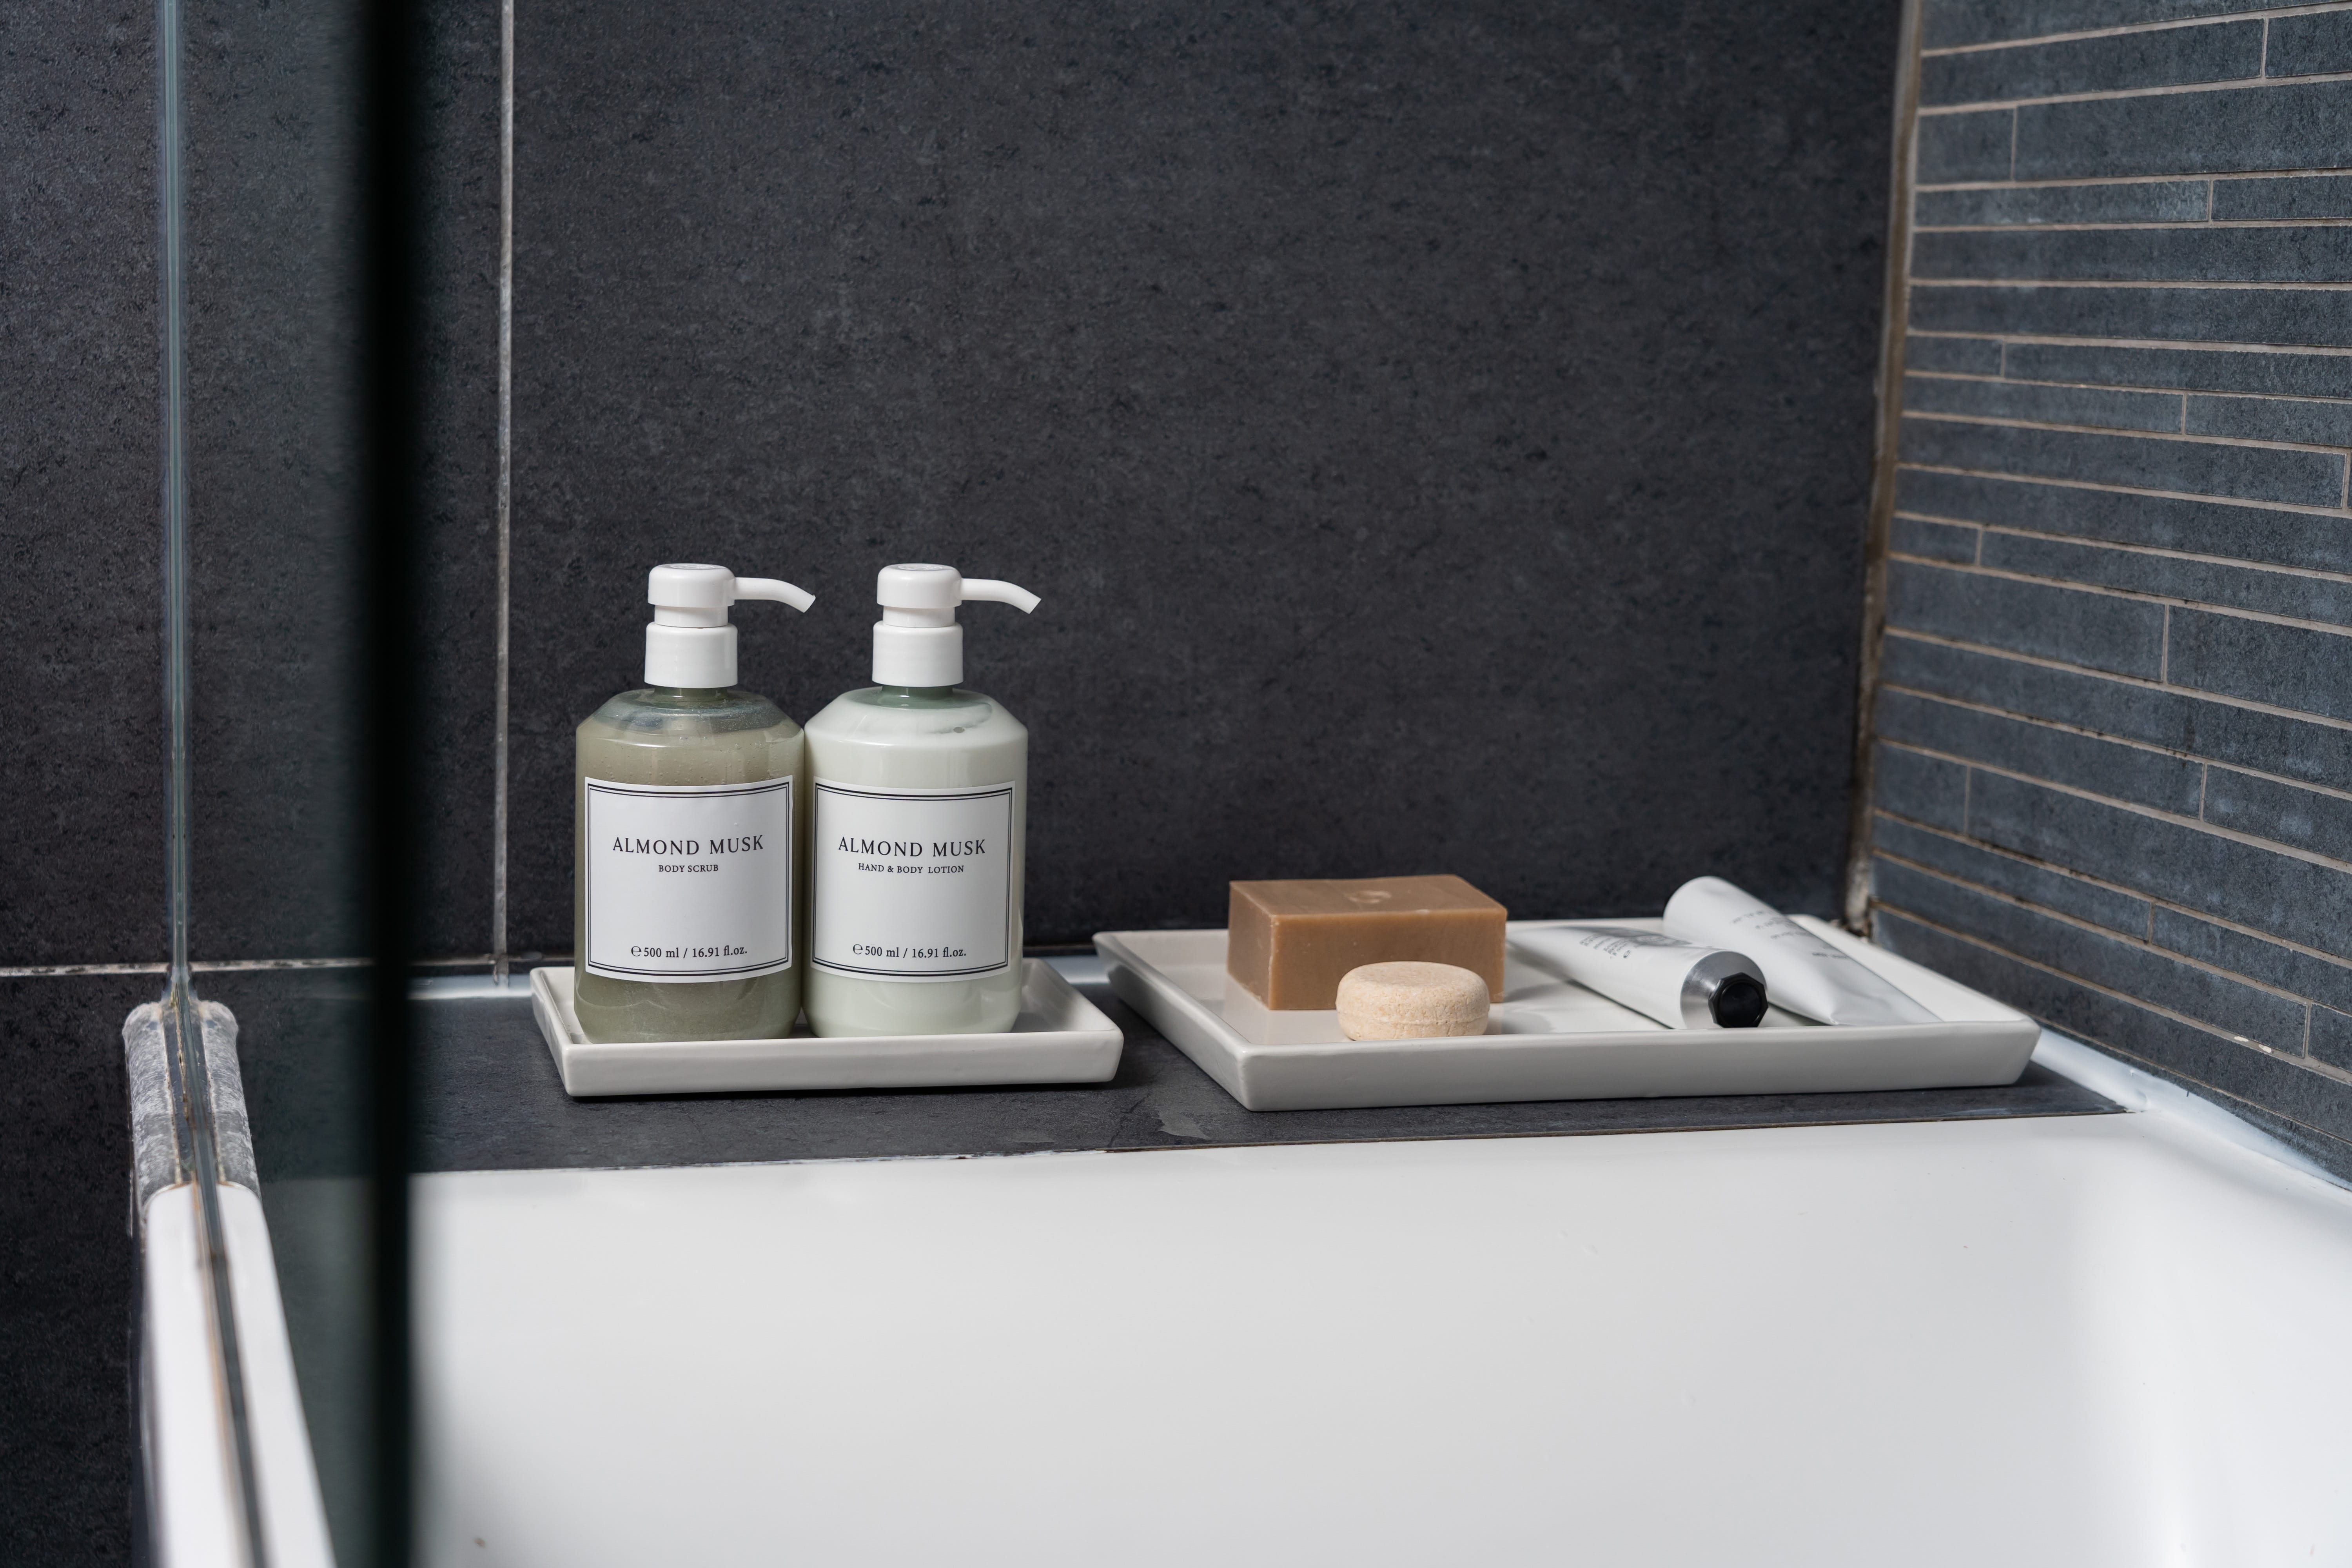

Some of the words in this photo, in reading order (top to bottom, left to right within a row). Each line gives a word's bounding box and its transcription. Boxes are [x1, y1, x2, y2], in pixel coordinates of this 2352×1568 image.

[612, 837, 699, 855] ALMOND
[710, 835, 764, 855] MUSK
[838, 836, 923, 857] ALMOND
[933, 839, 985, 857] MUSK
[687, 864, 719, 873] SCRUB
[858, 862, 884, 872] HAND
[897, 866, 924, 874] BODY
[927, 865, 964, 874] LOTION
[665, 947, 680, 958] ml
[683, 947, 688, 959] /
[692, 947, 720, 958] 16.91
[723, 945, 748, 956] fl.oz.
[886, 947, 900, 958] ml
[903, 947, 908, 959] /
[912, 948, 939, 958] 16.91
[942, 947, 966, 958] fl.oz.
